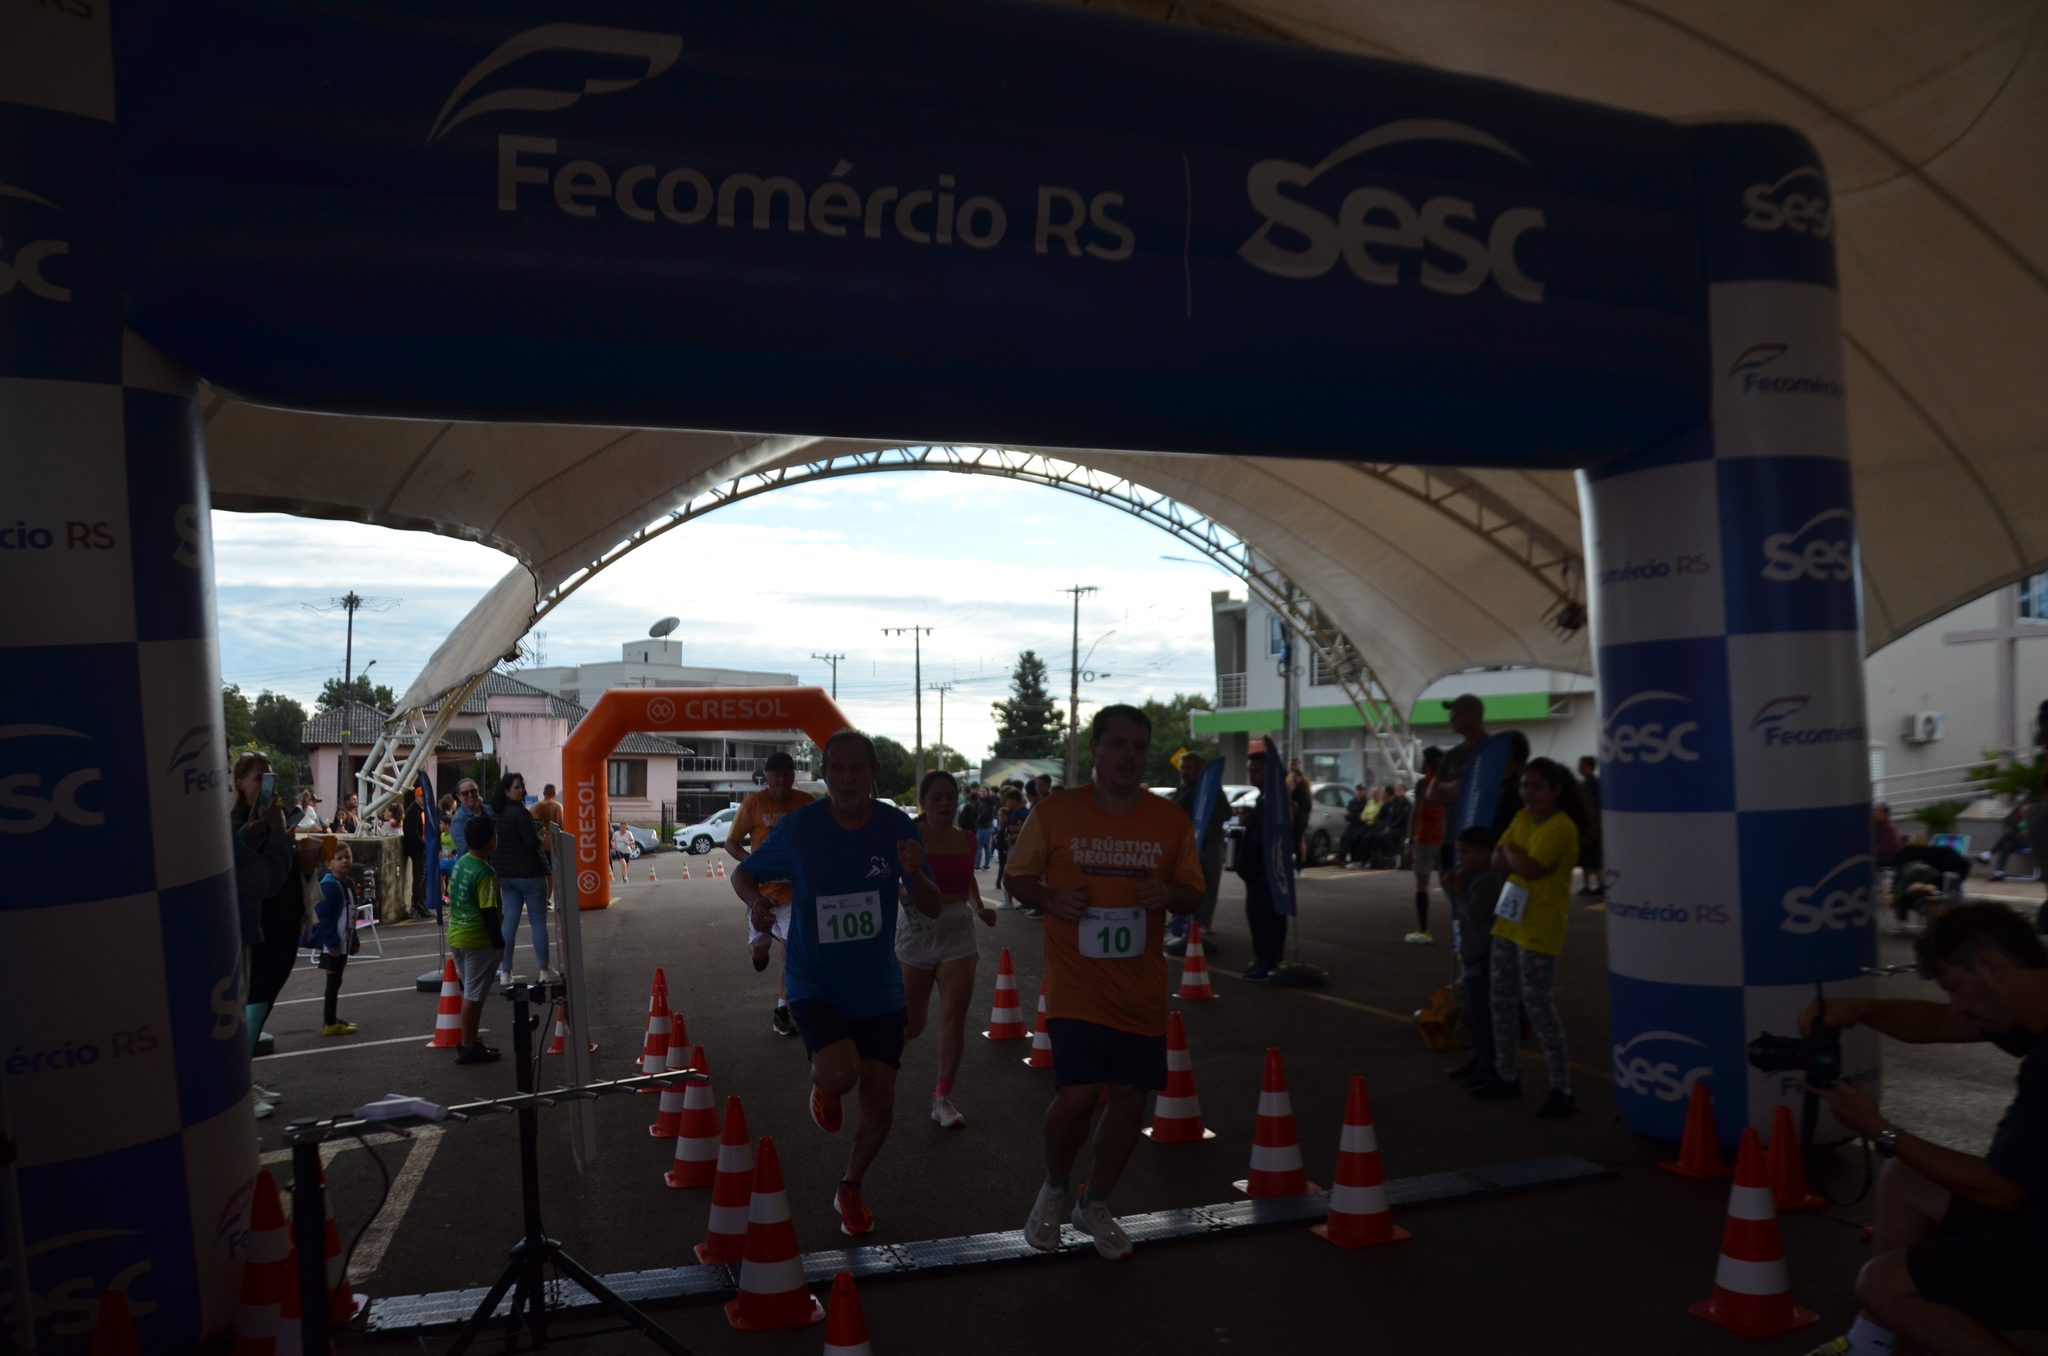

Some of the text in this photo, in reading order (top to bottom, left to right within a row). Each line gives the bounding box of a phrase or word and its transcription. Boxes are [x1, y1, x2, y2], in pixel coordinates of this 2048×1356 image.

[498, 134, 1135, 261] Fecomércio RS
[1237, 158, 1547, 304] Sesc
[66, 521, 116, 551] RS
[1678, 554, 1711, 574] RS
[684, 698, 789, 721] CRESOL
[578, 773, 597, 863] CRESOL
[1073, 850, 1159, 869] REGIONAL
[1091, 836, 1163, 856] RÚSTICA
[827, 911, 875, 940] 108
[1695, 903, 1730, 925] RS
[1097, 926, 1131, 953] 10
[112, 1025, 158, 1058] RS
